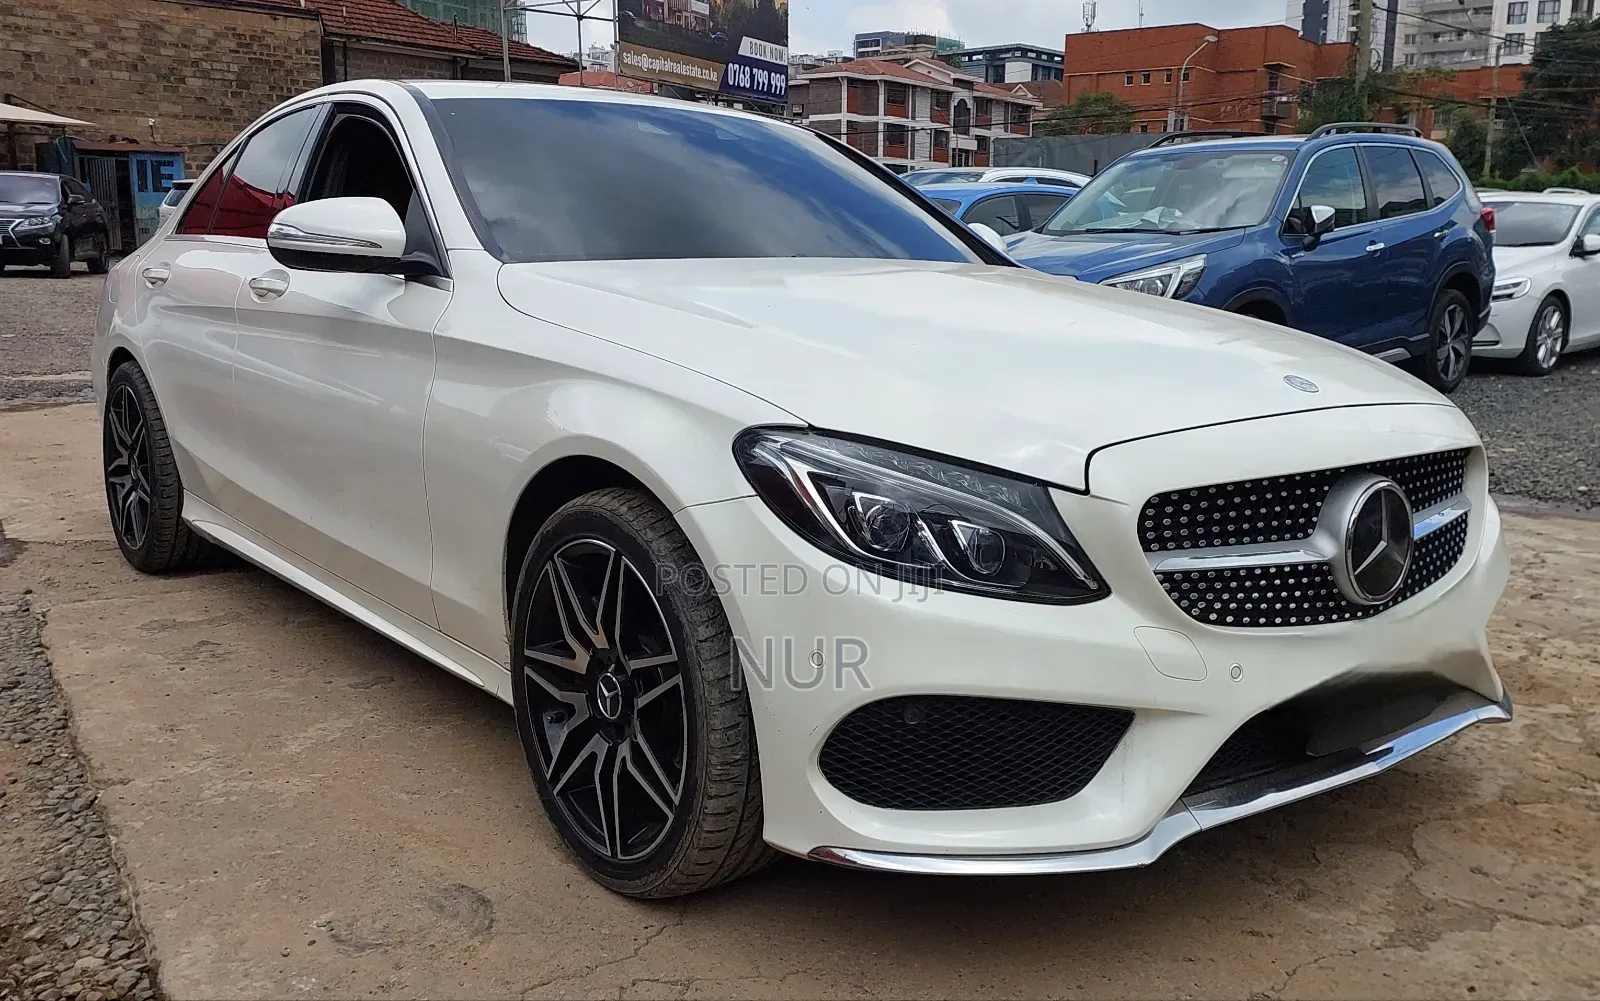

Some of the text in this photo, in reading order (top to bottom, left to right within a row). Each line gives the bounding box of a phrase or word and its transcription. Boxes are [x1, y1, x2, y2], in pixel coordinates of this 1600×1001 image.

[749, 40, 768, 59] BOOK
[622, 50, 718, 82] sales@capitalrealestate.co.ke
[727, 62, 786, 96] 0768 799 999
